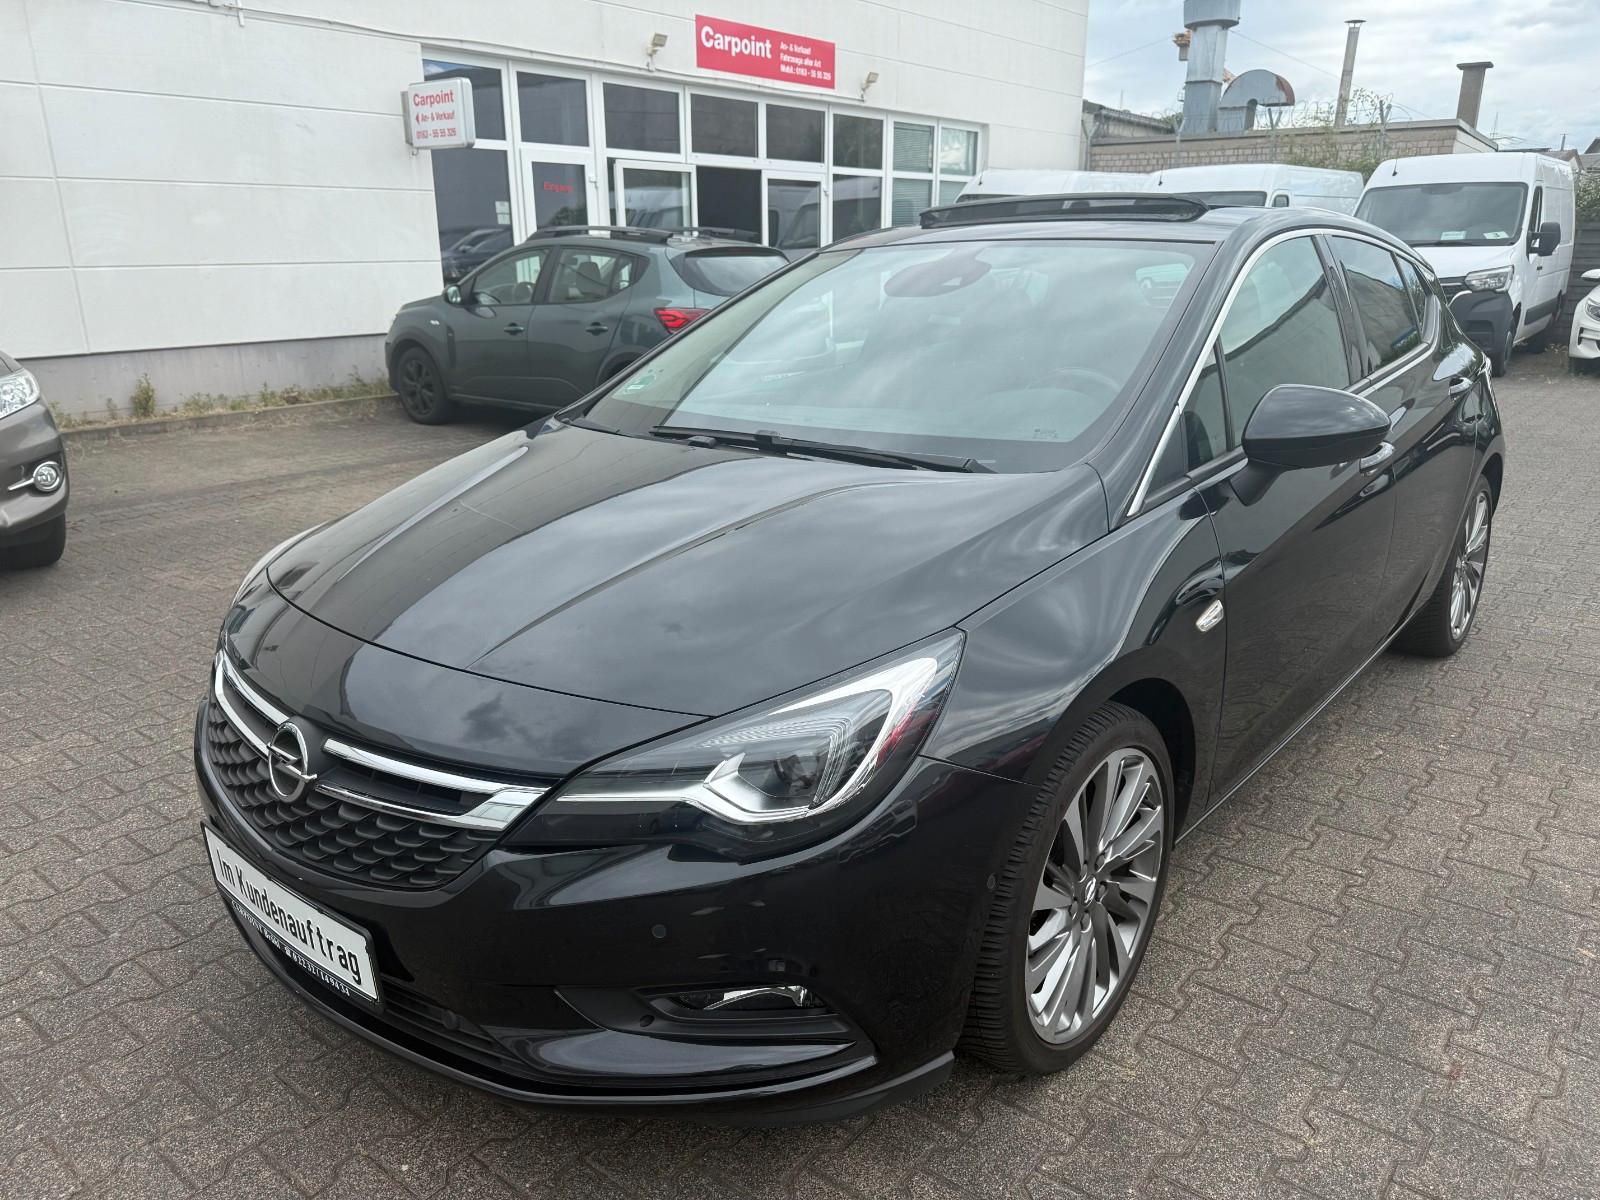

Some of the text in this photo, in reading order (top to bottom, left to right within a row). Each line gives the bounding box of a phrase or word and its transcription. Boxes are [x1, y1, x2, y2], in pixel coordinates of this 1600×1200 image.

[700, 25, 772, 59] Carpoint
[413, 90, 454, 108] Carpoint
[216, 849, 362, 985] Im Kundenauftrag
